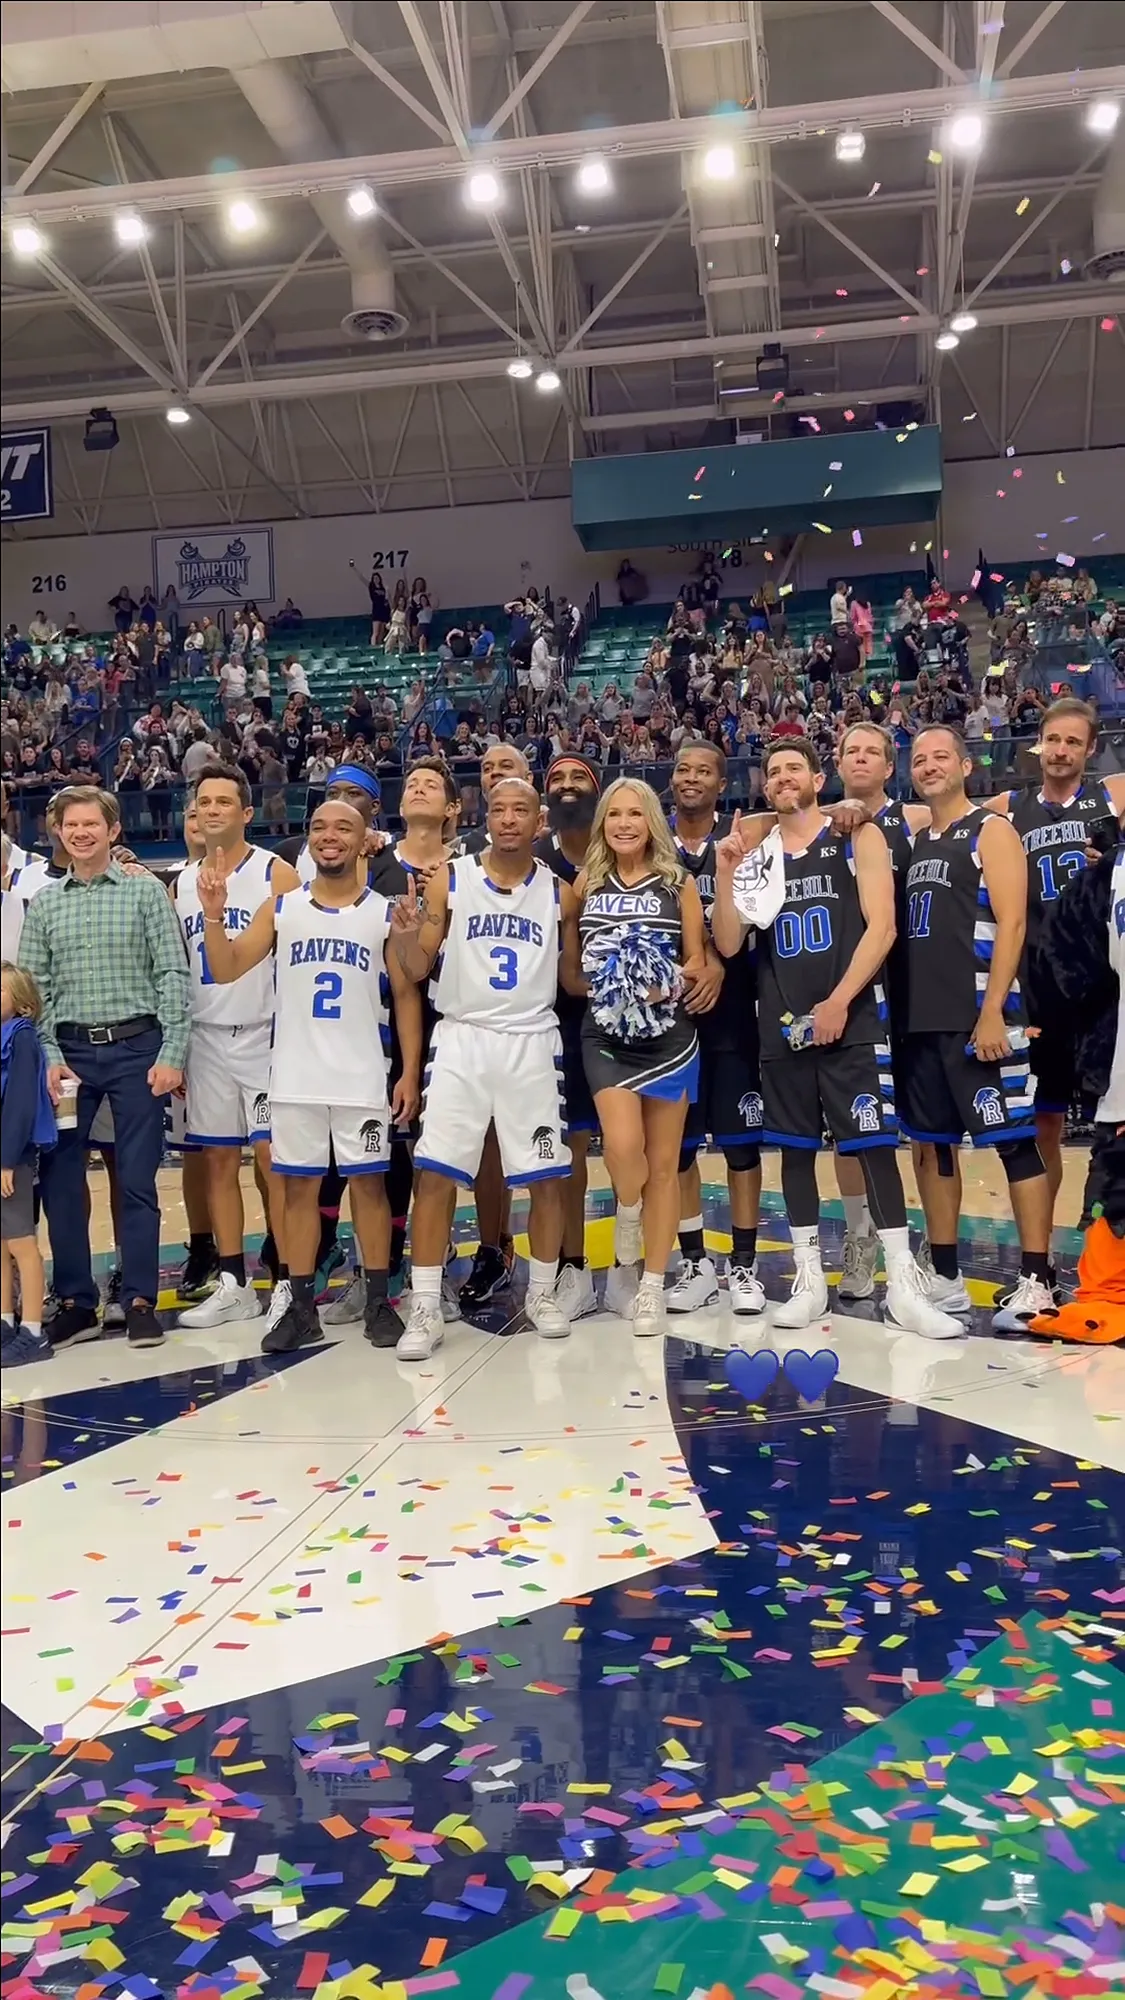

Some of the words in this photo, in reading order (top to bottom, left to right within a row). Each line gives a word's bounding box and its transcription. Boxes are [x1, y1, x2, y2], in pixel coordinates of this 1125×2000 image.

[181, 559, 246, 584] HAMPTON
[372, 550, 409, 570] 217
[32, 574, 67, 594] 216
[1078, 799, 1097, 810] KS
[883, 816, 900, 826] KS
[953, 828, 970, 840] KS
[820, 845, 838, 859] KS
[184, 906, 252, 940] RANS
[907, 890, 932, 939] 11
[466, 913, 543, 948] RAVENS
[774, 904, 833, 959] 00
[289, 937, 371, 972] RAVENS
[489, 945, 518, 991] 3
[312, 971, 343, 1019] 2
